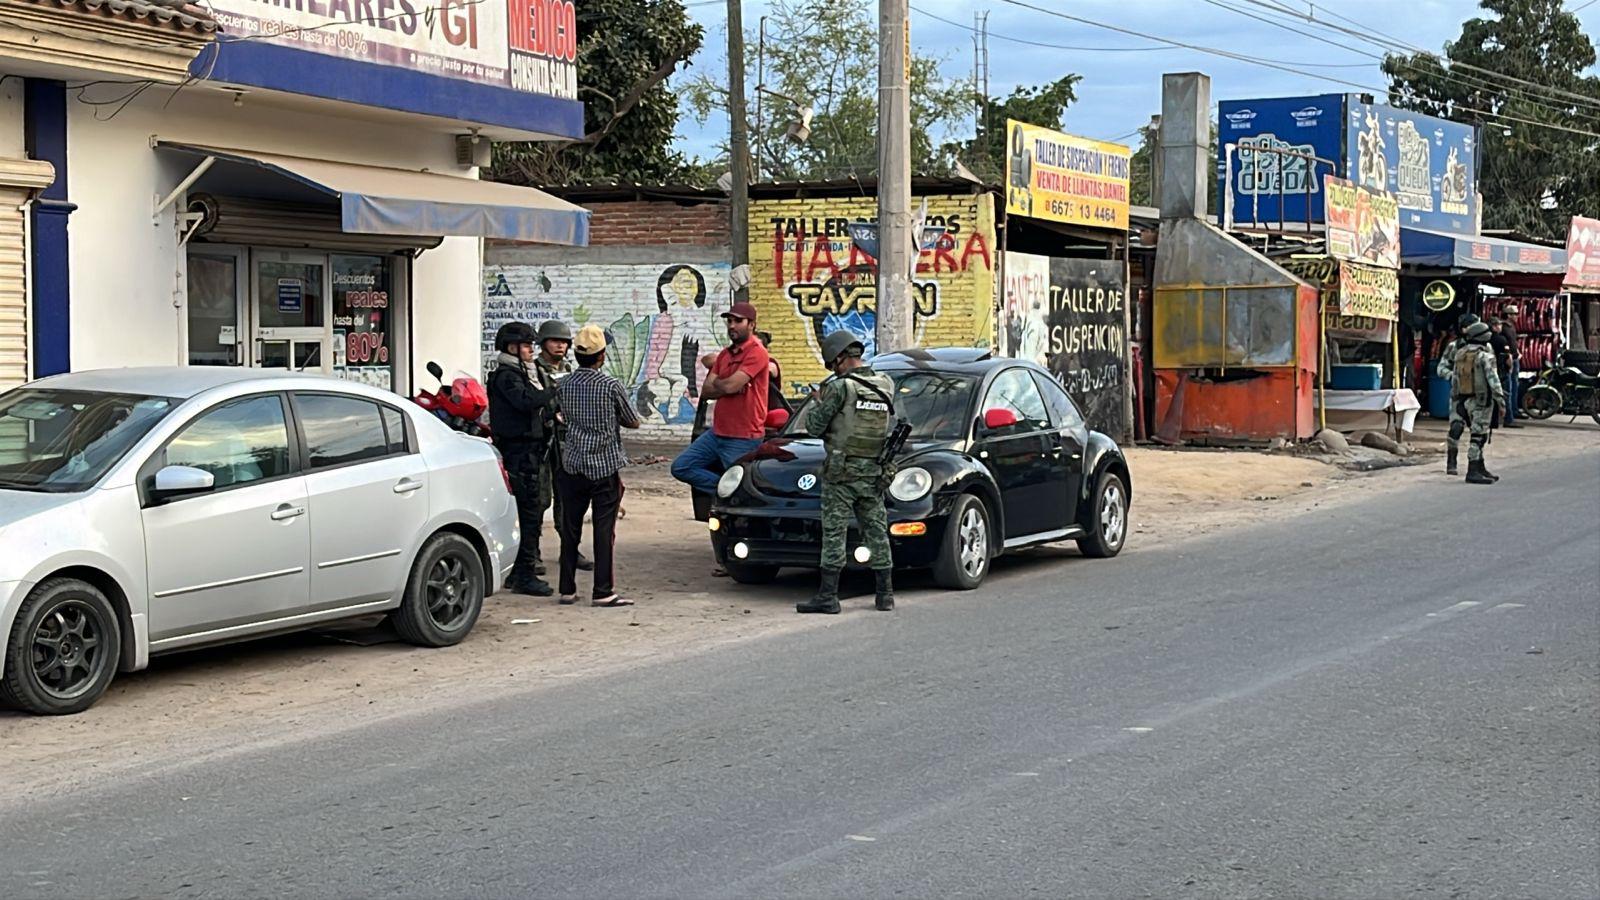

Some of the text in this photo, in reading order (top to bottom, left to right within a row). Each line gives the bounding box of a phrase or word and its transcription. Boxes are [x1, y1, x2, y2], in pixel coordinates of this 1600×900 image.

[337, 28, 369, 55] 80%
[442, 57, 461, 71] justo
[462, 62, 475, 74] por
[1035, 139, 1057, 167] TALLER
[1058, 144, 1066, 169] DE
[1108, 155, 1129, 180] FRENOS
[1037, 170, 1127, 203] VENTA DE LLANTAS DANIEL
[770, 217, 850, 238] TALLER
[333, 272, 376, 285] Descuentos
[345, 287, 388, 309] reales
[788, 282, 938, 317] TAYRN
[1050, 285, 1123, 314] TALLER DE
[333, 314, 365, 326] hasta del
[347, 332, 389, 363] 80%
[1051, 324, 1123, 360] SUSPENCION
